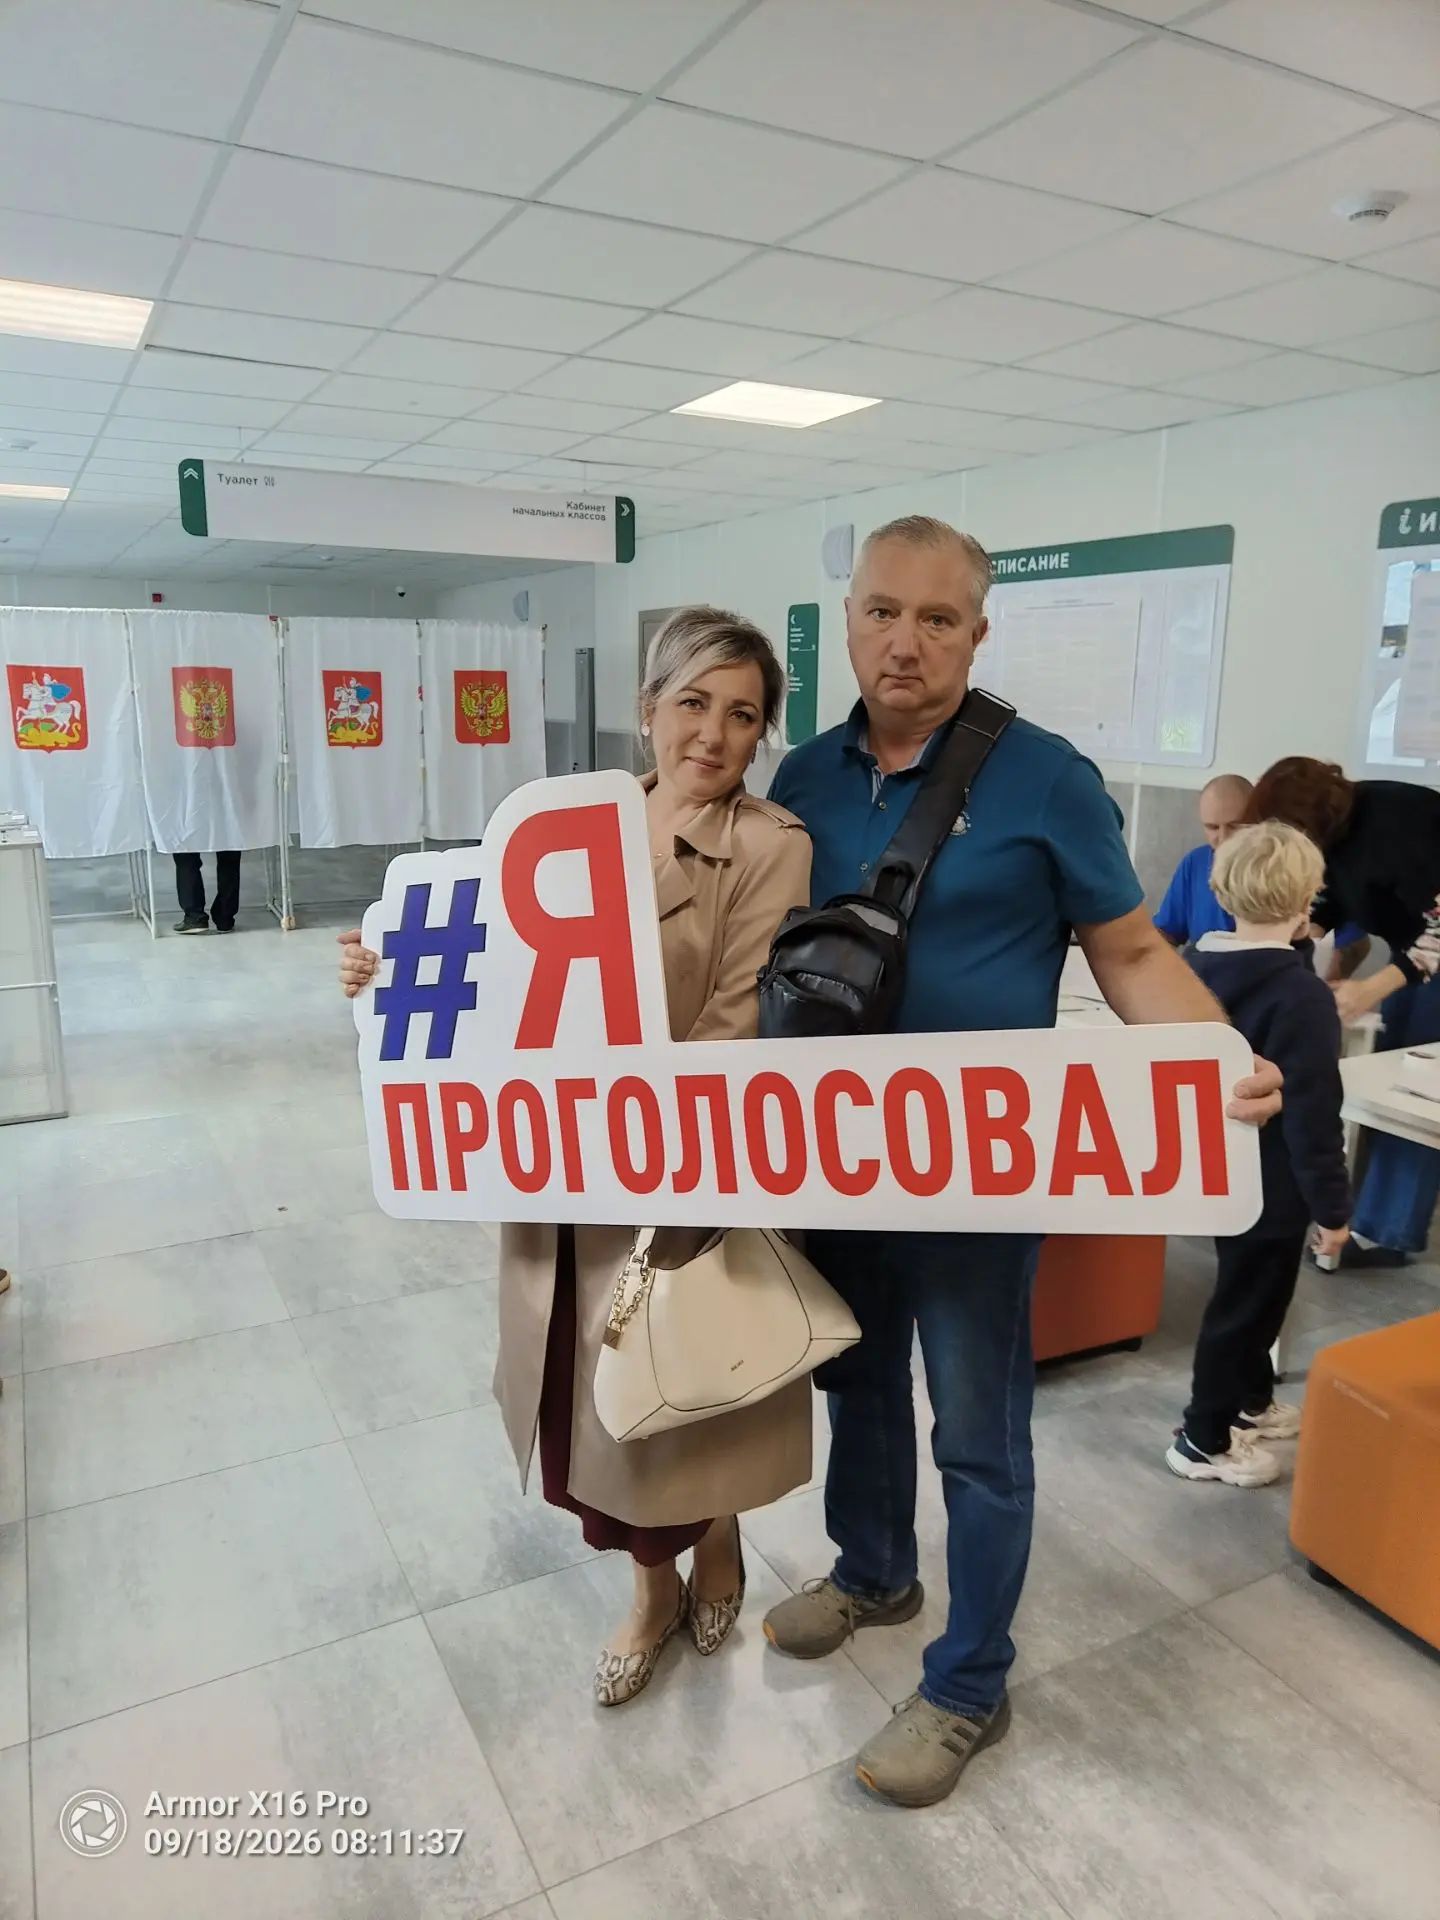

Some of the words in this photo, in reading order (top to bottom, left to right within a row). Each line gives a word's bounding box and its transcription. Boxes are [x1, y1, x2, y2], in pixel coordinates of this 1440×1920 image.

[217, 473, 258, 486] Туалет
[512, 506, 565, 518] начальных
[568, 511, 606, 521] классов
[566, 501, 606, 513] Кабинет
[1419, 511, 1440, 533] И
[381, 1058, 1230, 1197] ПРОГОЛОСОВАЛ
